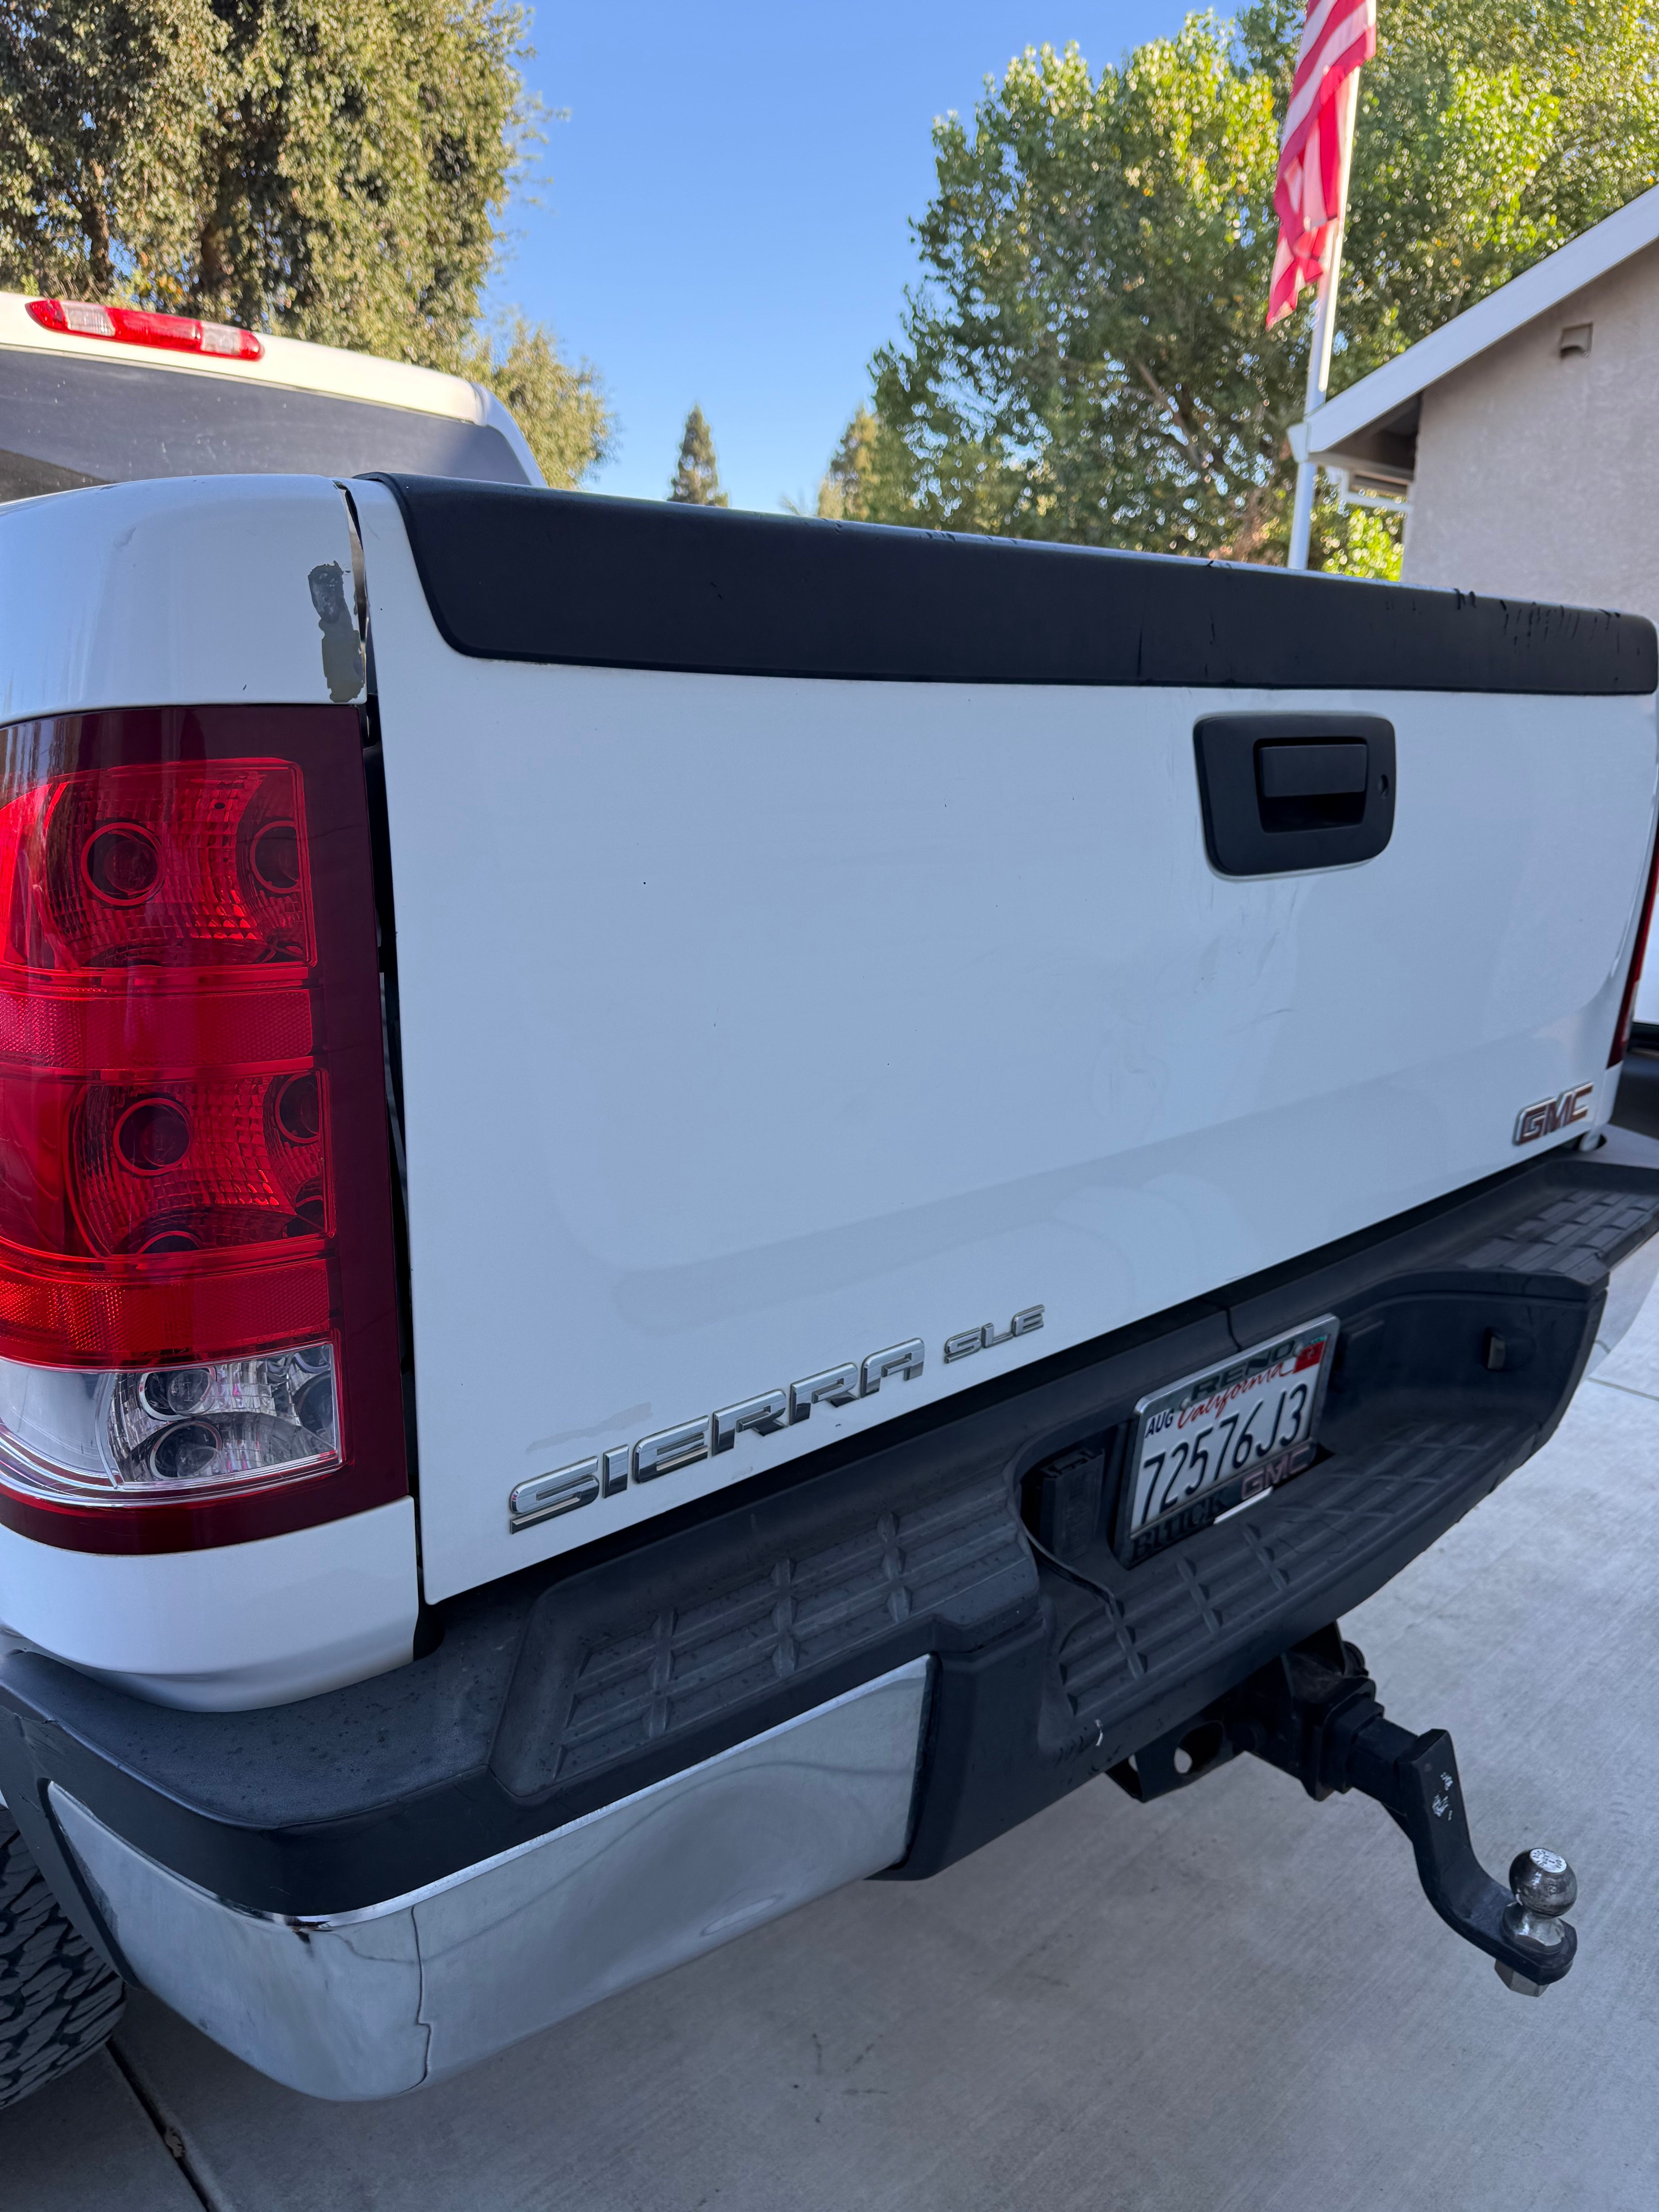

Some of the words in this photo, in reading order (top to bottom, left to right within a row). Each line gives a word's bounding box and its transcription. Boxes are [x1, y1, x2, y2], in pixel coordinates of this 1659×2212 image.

[1512, 1080, 1594, 1146] GMC
[1178, 1362, 1294, 1429] California
[1190, 1340, 1295, 1401] RENO
[510, 1338, 925, 1535] SIERRA
[945, 1304, 1045, 1364] SLE
[1145, 1408, 1175, 1438] AUG
[1142, 1383, 1308, 1525] 72576J3
[1131, 1487, 1229, 1562] BUICK
[1242, 1445, 1309, 1500] GMC
